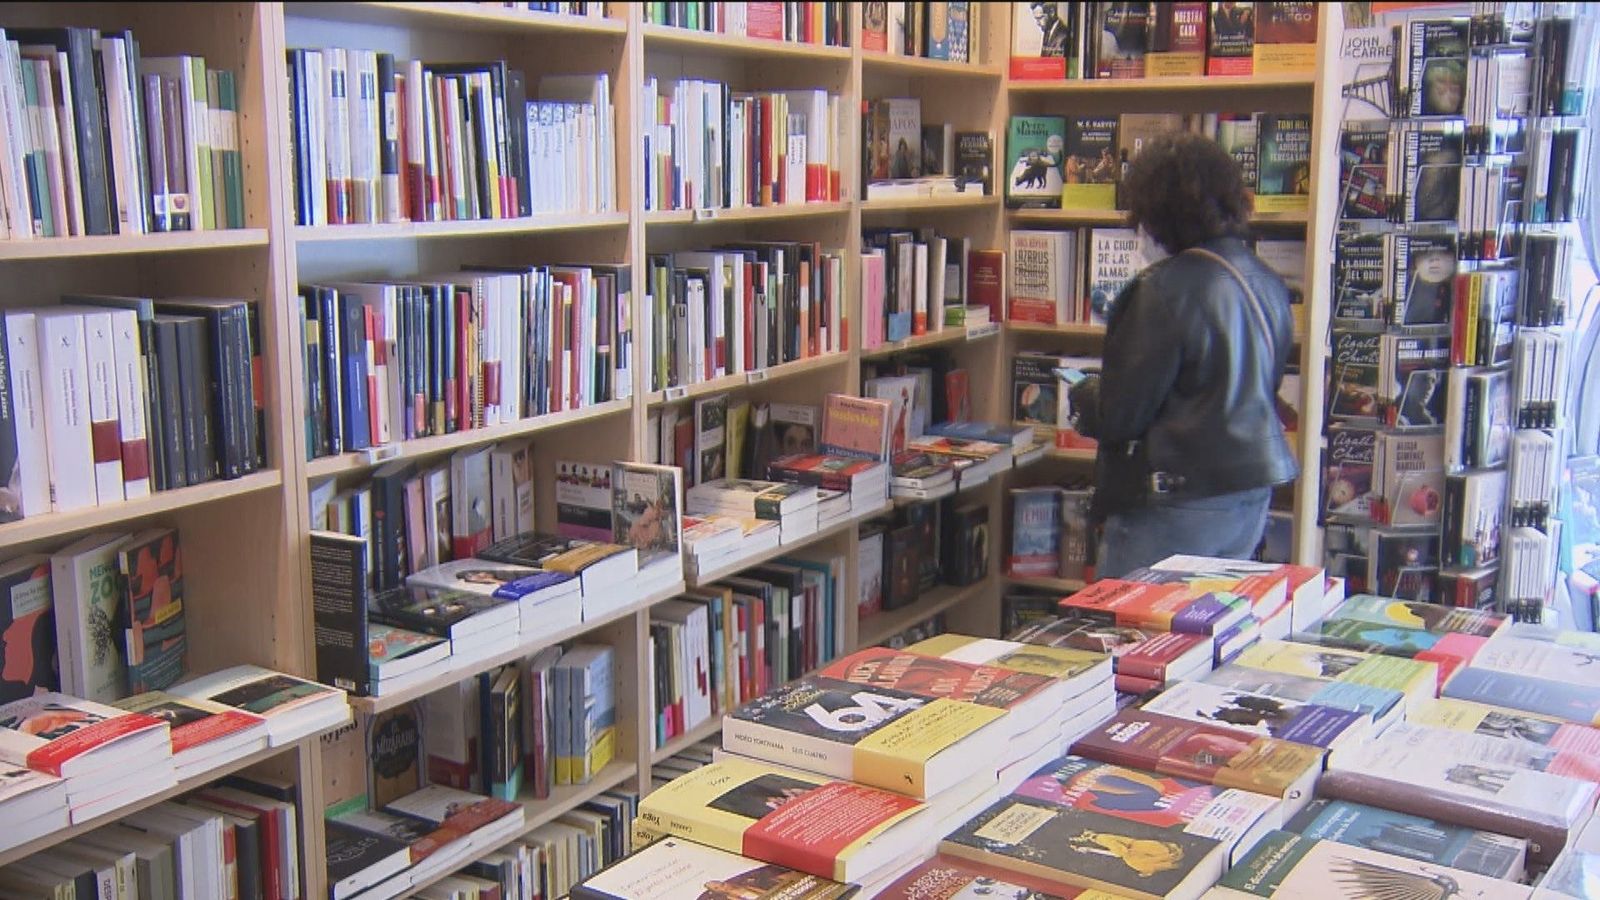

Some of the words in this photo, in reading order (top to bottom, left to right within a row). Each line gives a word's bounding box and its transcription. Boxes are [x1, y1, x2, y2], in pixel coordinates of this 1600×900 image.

[1347, 36, 1380, 48] JOHN
[1098, 239, 1110, 251] LA
[1014, 250, 1049, 265] LAZARUS
[1098, 253, 1110, 265] DE
[1112, 253, 1130, 265] LAS
[1097, 267, 1129, 279] ALMAS
[734, 734, 753, 744] HIDEO
[642, 811, 661, 827] Yoga
